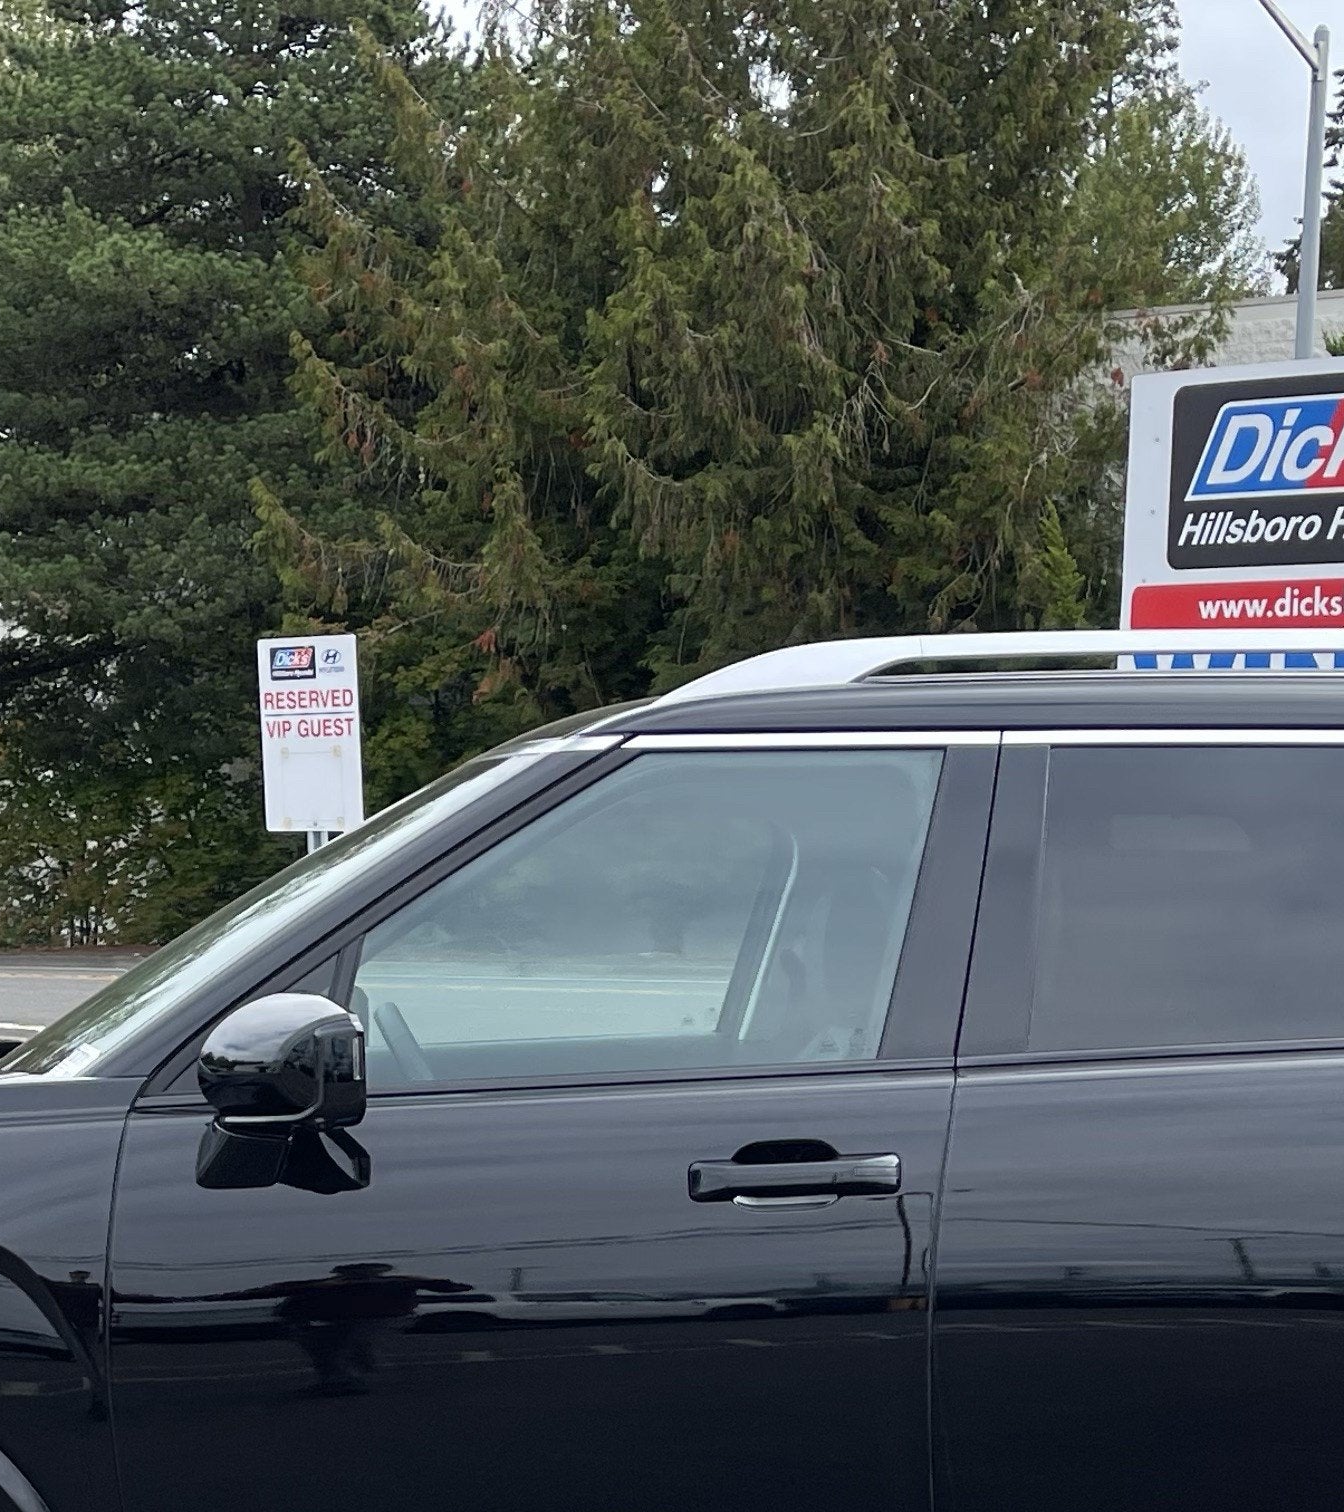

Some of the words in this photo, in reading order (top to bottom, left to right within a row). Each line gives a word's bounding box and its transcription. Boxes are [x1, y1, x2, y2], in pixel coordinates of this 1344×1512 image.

[1178, 510, 1322, 546] Hillsboro
[264, 689, 354, 710] RESERVED
[265, 720, 292, 738] VIP
[297, 717, 354, 738] GUEST
